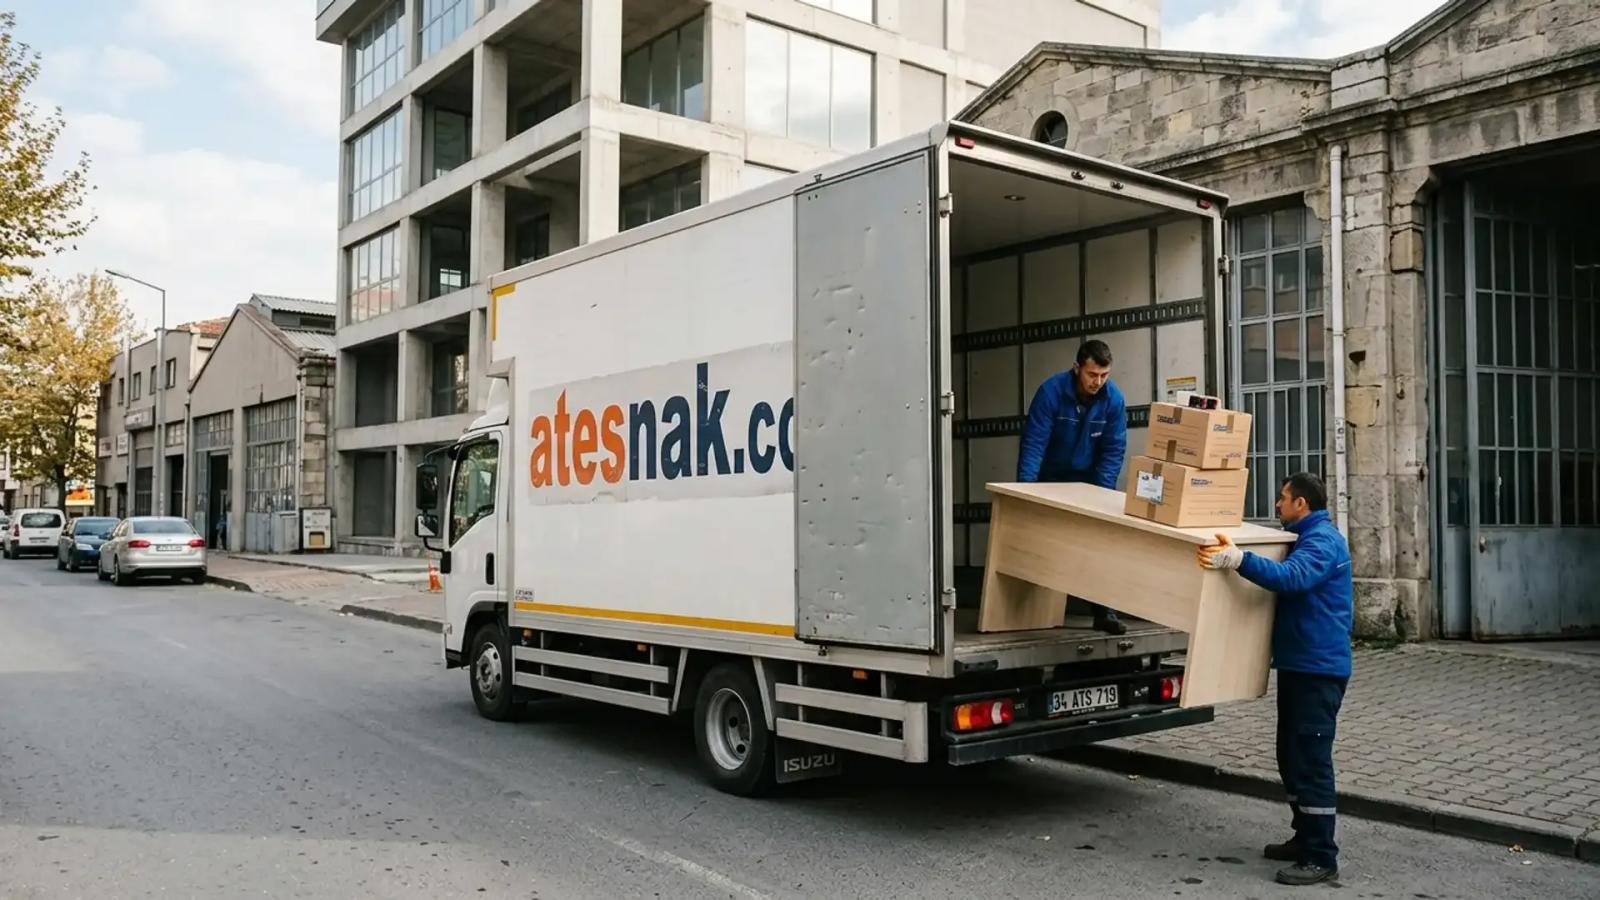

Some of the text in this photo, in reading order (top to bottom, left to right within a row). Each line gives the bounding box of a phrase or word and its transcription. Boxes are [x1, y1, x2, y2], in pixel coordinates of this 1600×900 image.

[1054, 693, 1067, 711] 34
[1072, 689, 1092, 708] ATS
[1096, 687, 1116, 704] 719
[784, 753, 835, 772] ISUZU
